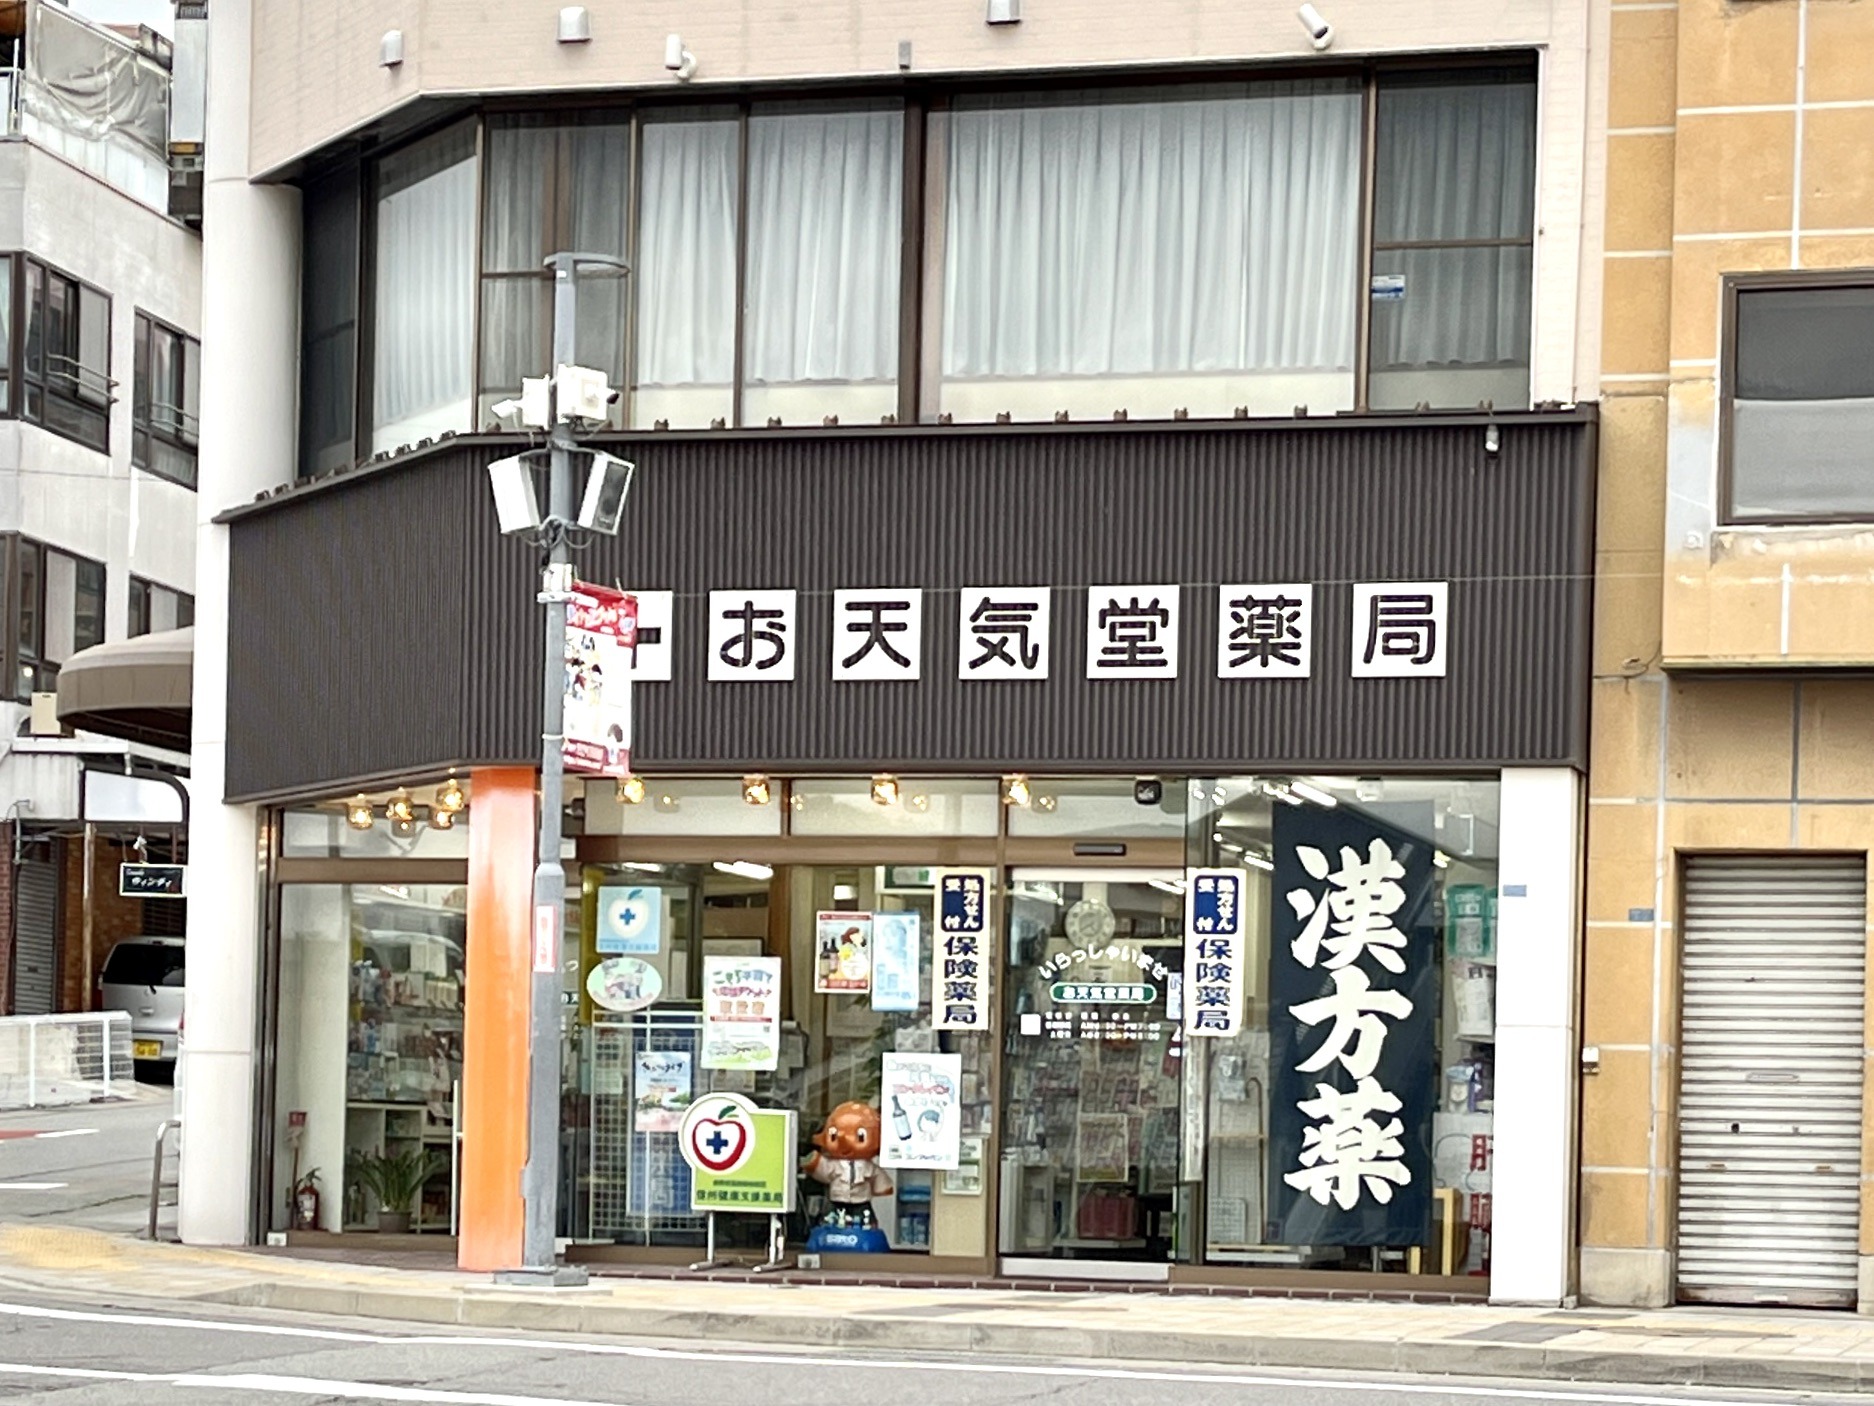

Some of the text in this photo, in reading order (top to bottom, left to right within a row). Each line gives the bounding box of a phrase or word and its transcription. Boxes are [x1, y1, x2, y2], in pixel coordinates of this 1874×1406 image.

[720, 595, 1436, 670] お天気堂薬局
[943, 936, 979, 1024] 保険薬局
[1038, 943, 1169, 981] いらっしゃいませ
[1195, 938, 1233, 1030] 保険薬局
[1284, 838, 1414, 1211] 漢方薬
